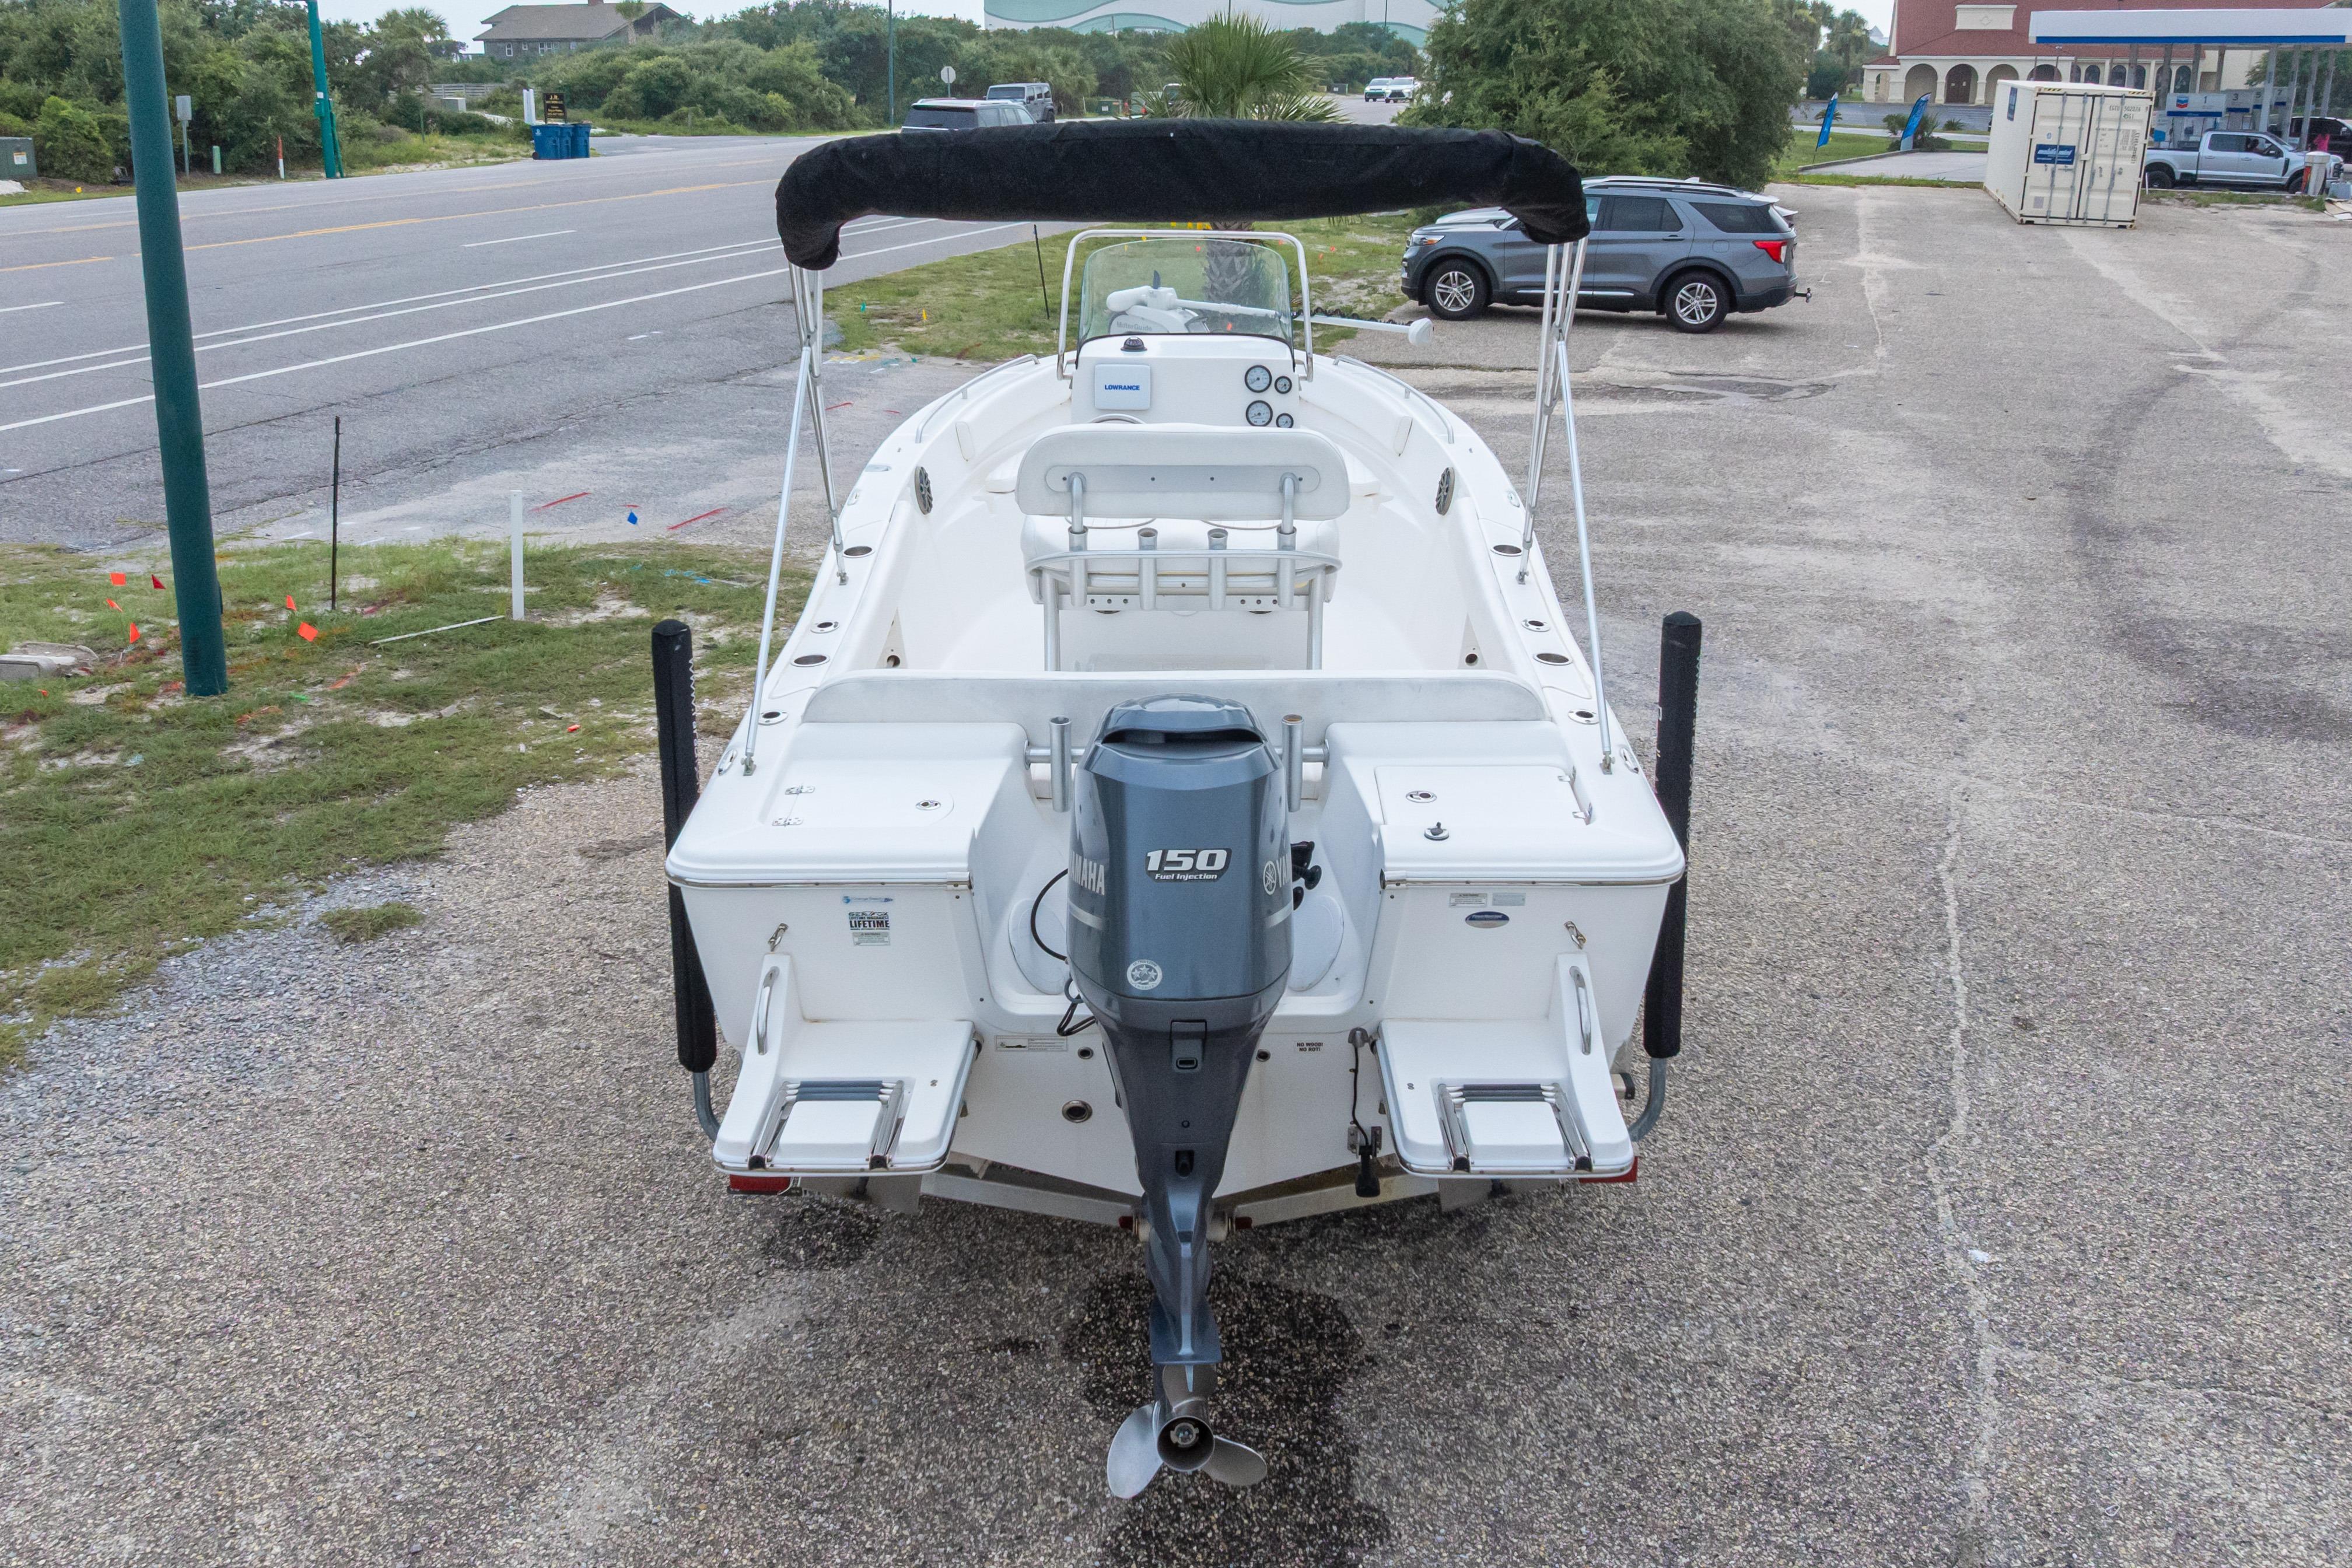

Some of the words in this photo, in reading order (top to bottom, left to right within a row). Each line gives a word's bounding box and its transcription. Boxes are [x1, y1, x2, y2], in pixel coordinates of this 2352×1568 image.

[2203, 96, 2208, 104] 1
[1116, 321, 1152, 331] MotorGuide
[1146, 849, 1227, 871] 150
[1069, 849, 1105, 895] AMAHA
[1176, 873, 1217, 881] Injection
[849, 920, 890, 928] LIFETIME
